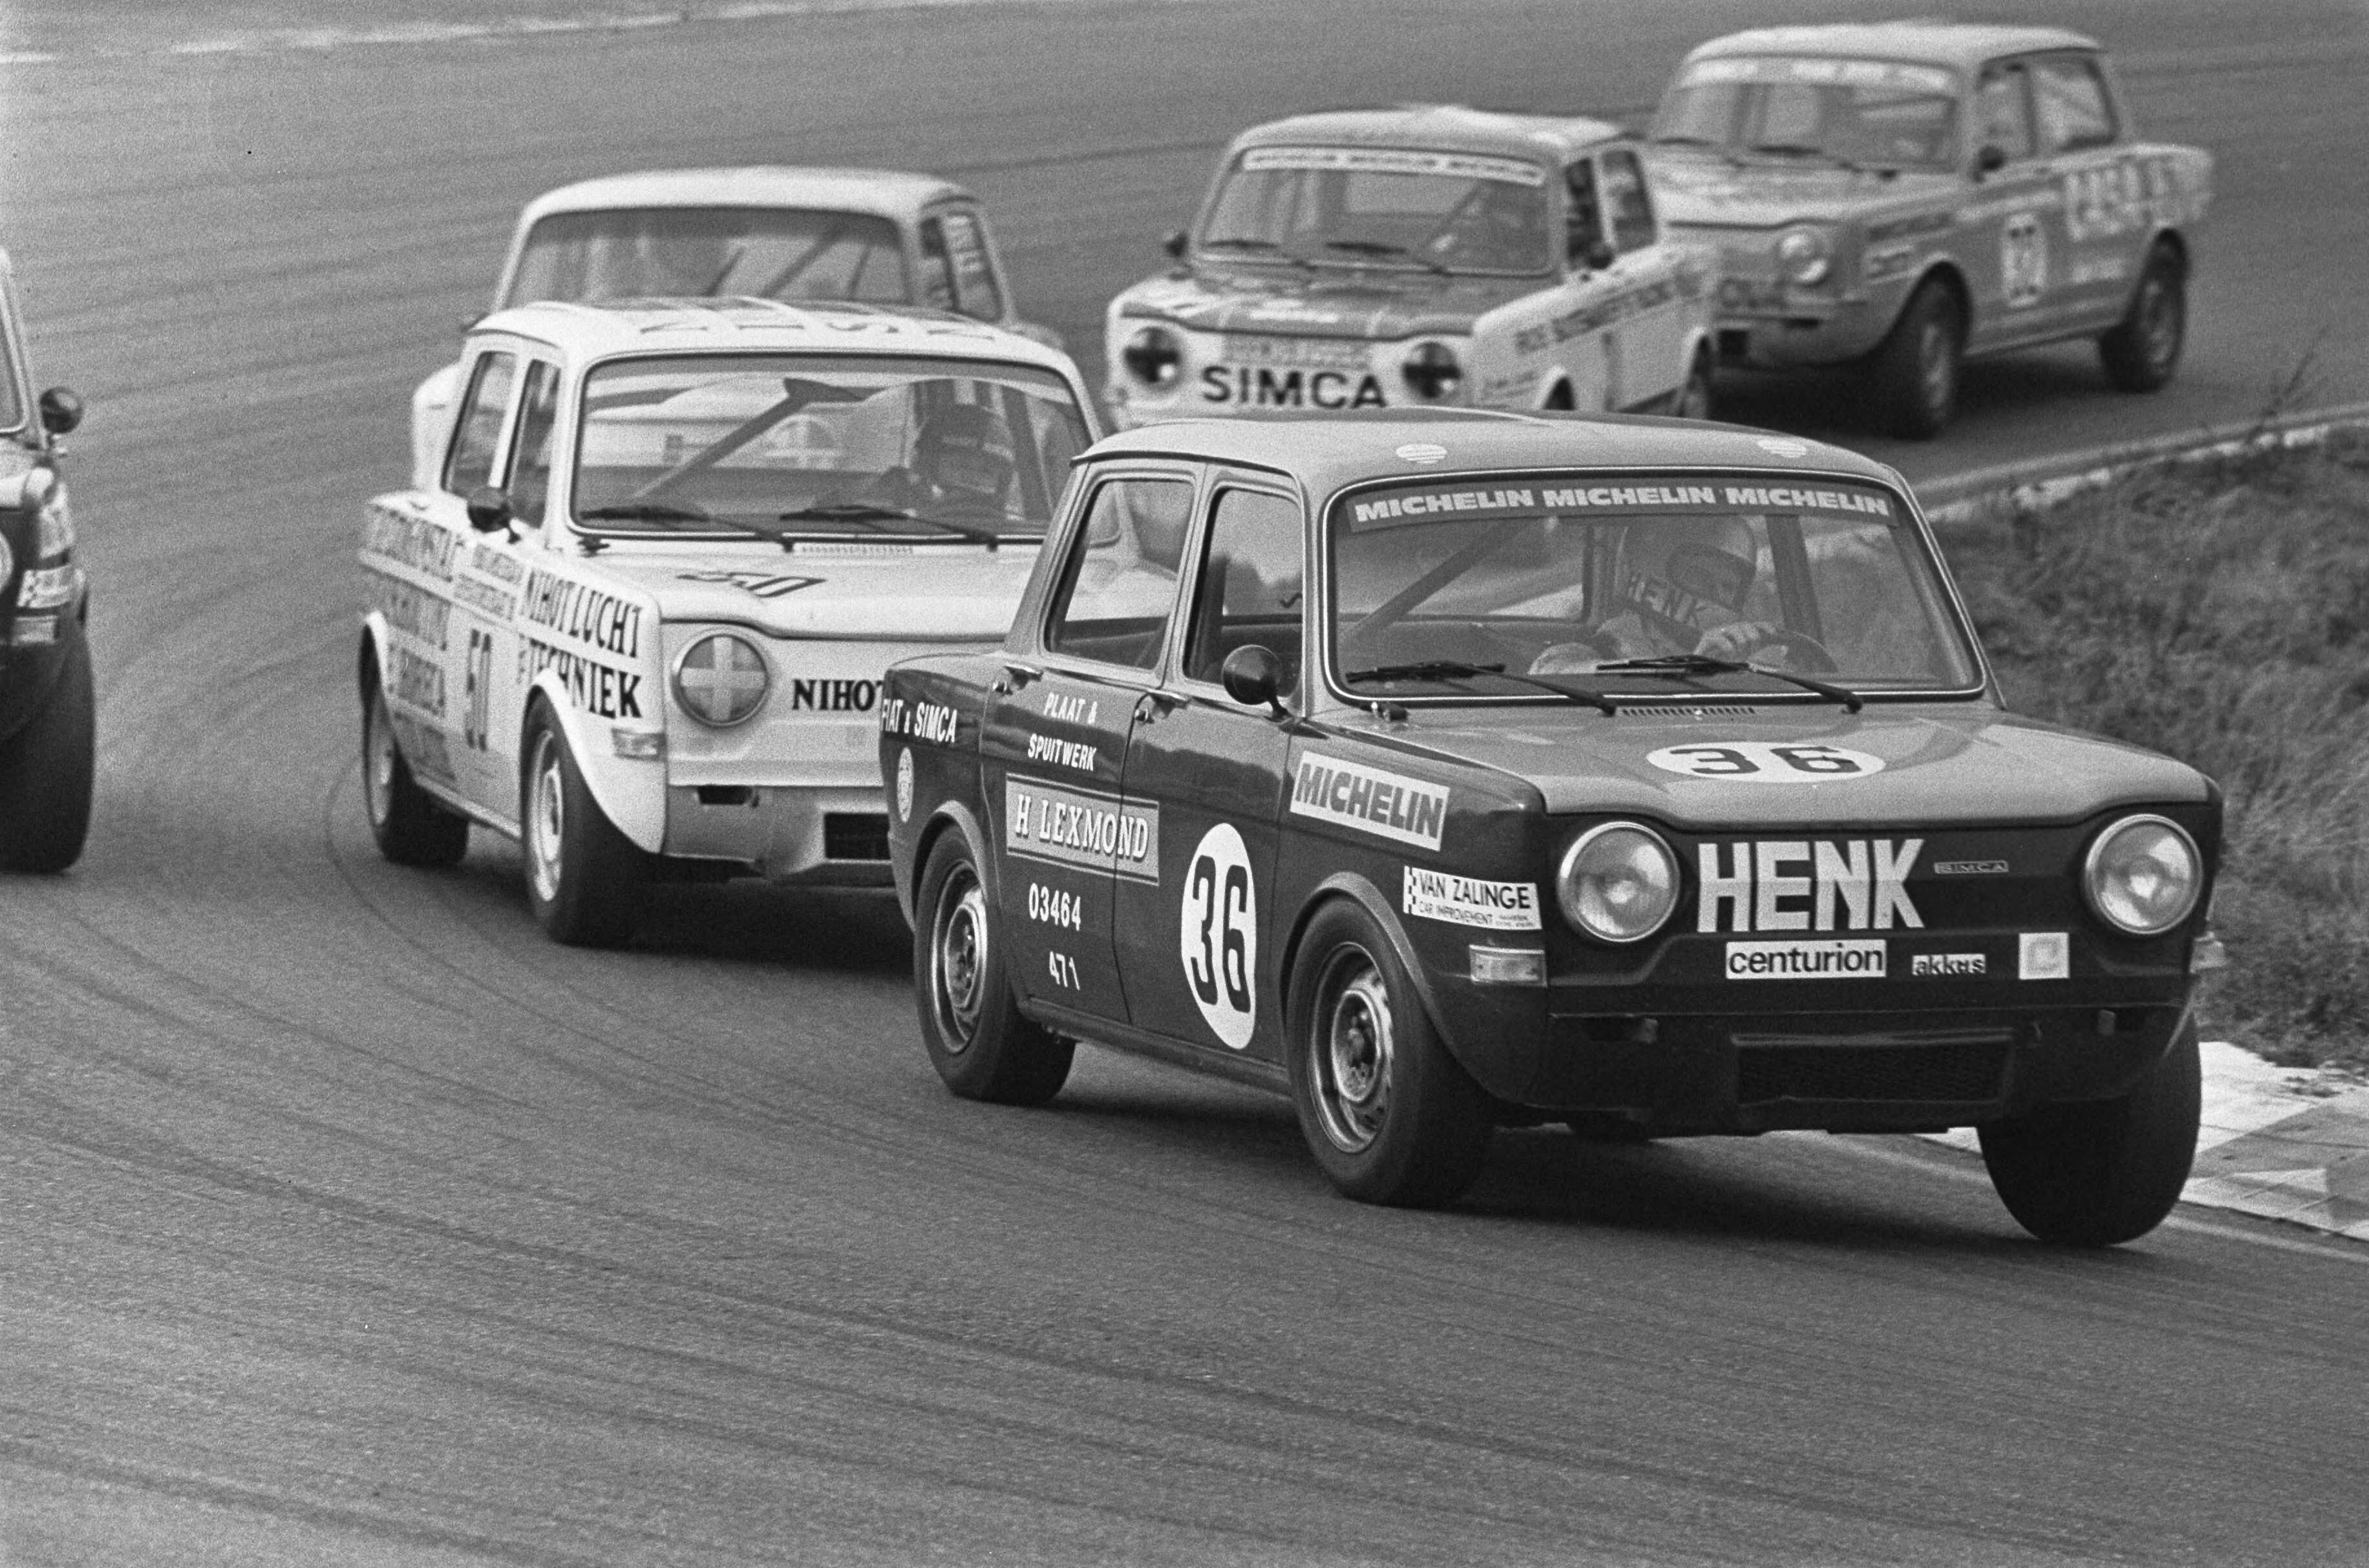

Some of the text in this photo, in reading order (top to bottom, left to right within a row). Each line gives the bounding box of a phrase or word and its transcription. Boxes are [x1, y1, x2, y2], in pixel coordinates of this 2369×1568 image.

[1202, 365, 1386, 408] SIMCA
[1355, 487, 1889, 522] MICHELIN MICHELIN MICHELIN
[569, 586, 643, 658] LUCHT
[915, 702, 957, 743] SIMCA
[1044, 692, 1085, 723] PLAAT
[1028, 733, 1097, 771] SPUITWERK
[1670, 746, 1862, 774] 36
[1295, 763, 1443, 840] MICHELIN
[1015, 794, 1149, 862] H LEXMOND
[1419, 872, 1531, 909] VAN ZALINGE
[1697, 839, 1925, 933] HENK
[1029, 883, 1081, 931] 03464
[1190, 854, 1252, 1013] 36
[1049, 951, 1080, 991] 471
[1729, 942, 1884, 974] centurion
